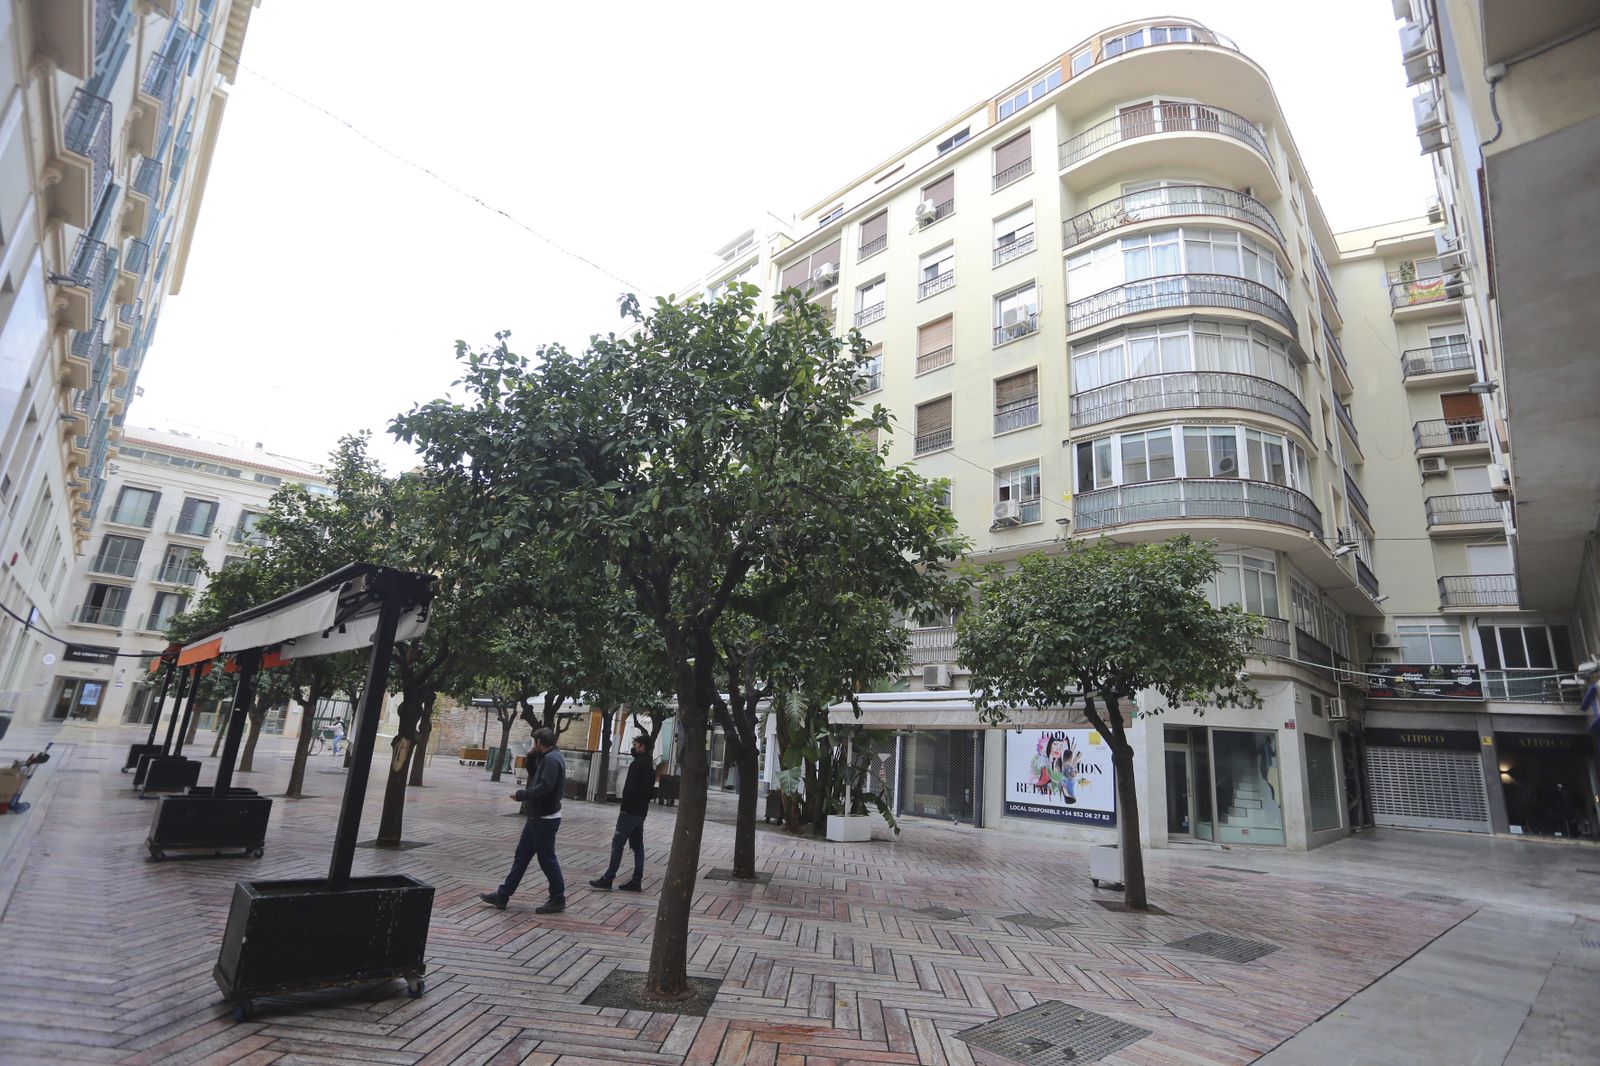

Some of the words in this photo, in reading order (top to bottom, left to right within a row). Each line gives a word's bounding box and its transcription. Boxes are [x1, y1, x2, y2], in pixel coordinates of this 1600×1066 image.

[1400, 733, 1445, 744] ATIPICO
[1519, 737, 1571, 748] ATIPICO
[1009, 804, 1028, 812] LOCAL
[1028, 807, 1060, 815] DISPONIBLE
